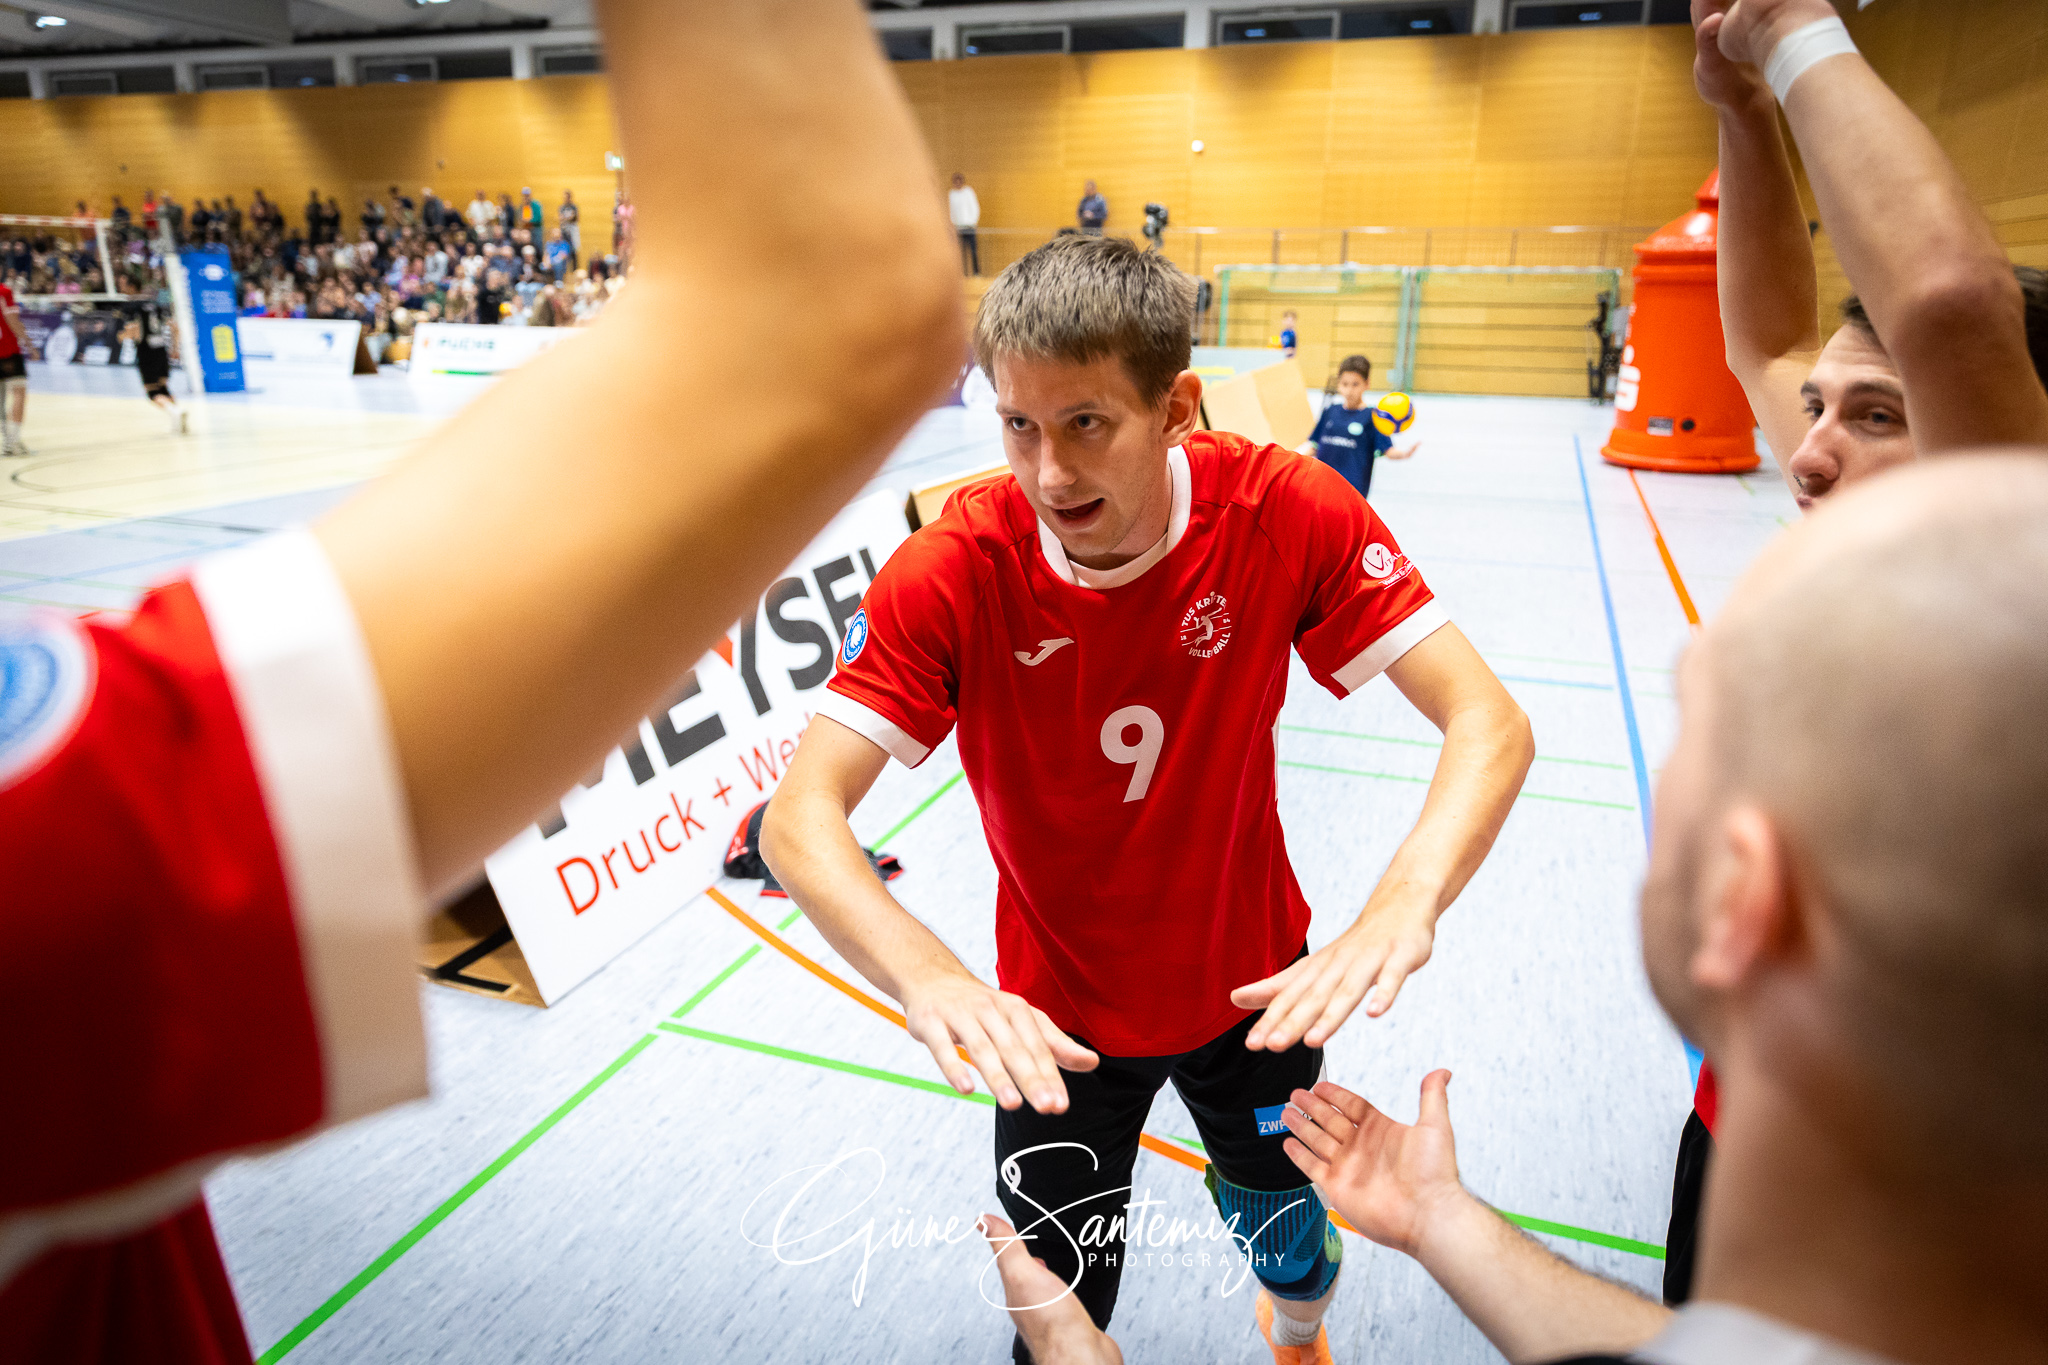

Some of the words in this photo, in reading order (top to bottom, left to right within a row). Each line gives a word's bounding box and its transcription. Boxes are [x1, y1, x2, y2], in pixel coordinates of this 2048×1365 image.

[1181, 607, 1195, 626] TUS
[1195, 595, 1226, 610] KRIFTE
[1100, 705, 1164, 803] 9
[556, 792, 705, 915] Druck
[739, 711, 811, 791] We
